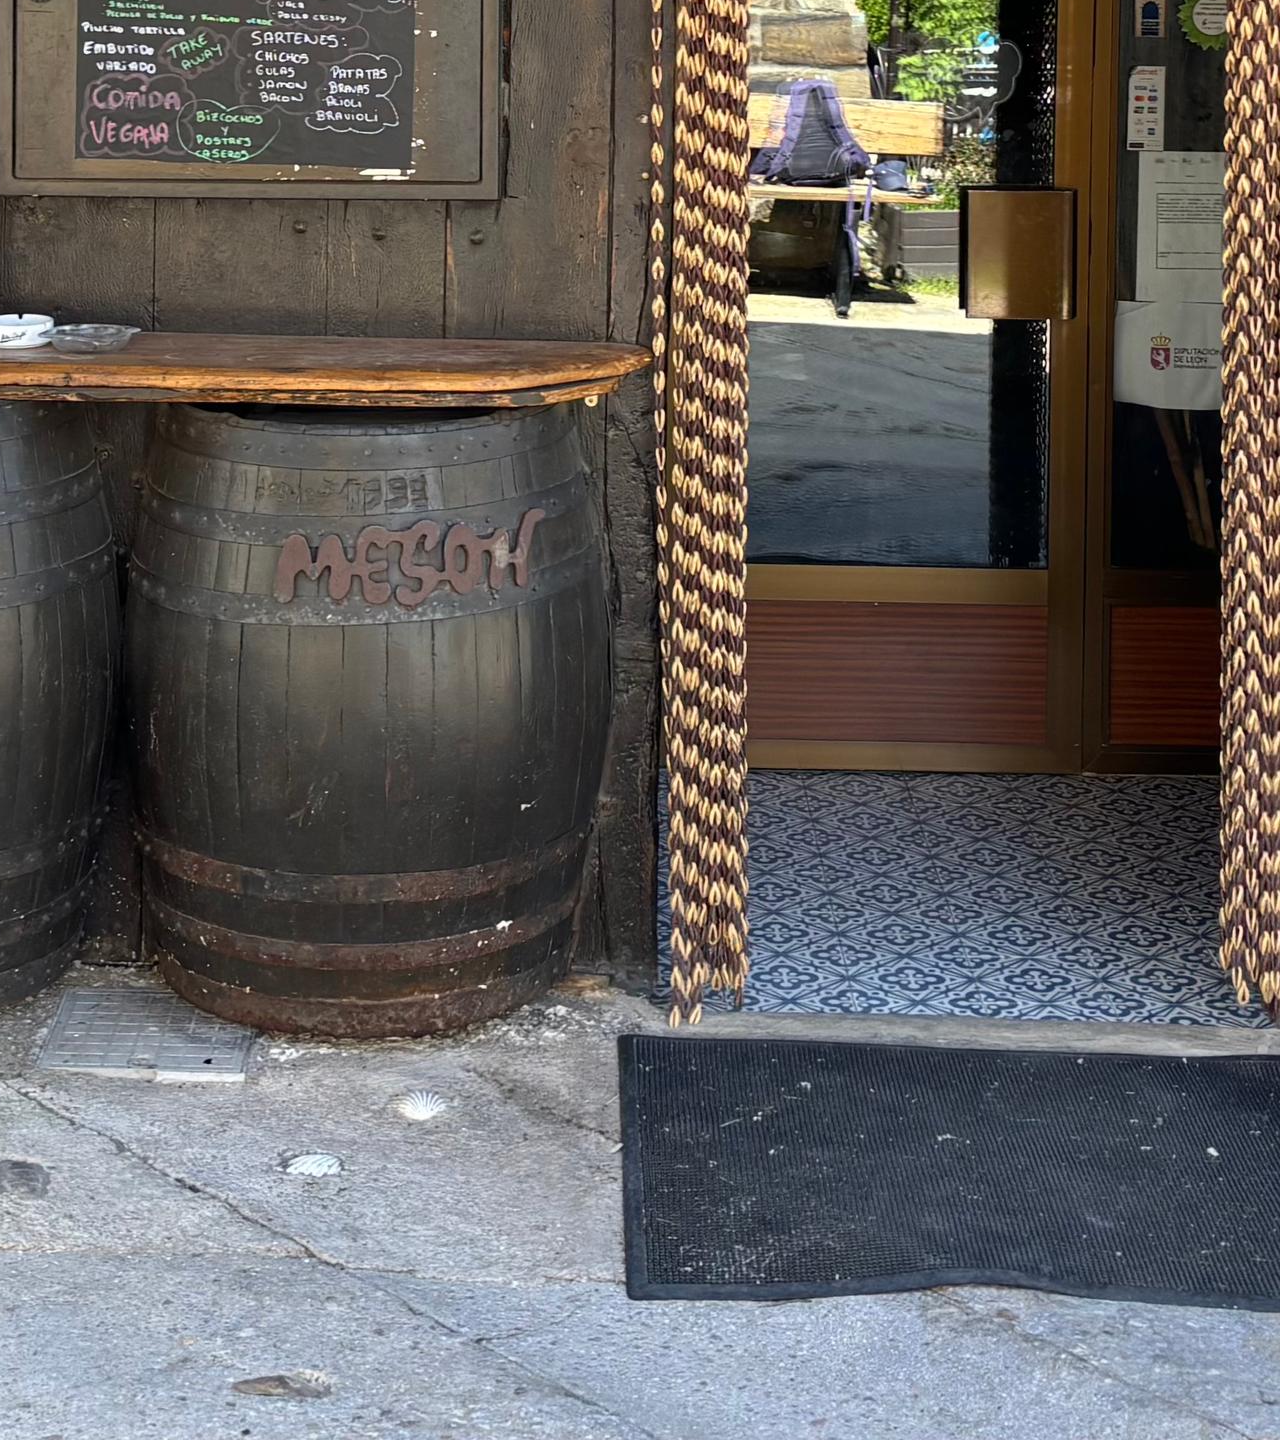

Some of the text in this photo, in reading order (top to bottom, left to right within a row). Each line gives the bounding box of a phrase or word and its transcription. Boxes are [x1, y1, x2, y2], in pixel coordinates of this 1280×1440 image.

[277, 0, 305, 9] VACA
[277, 11, 348, 25] POLLO CRISPY
[83, 41, 155, 56] EMBUTIDO
[166, 32, 208, 59] TAKE
[181, 43, 223, 71] AWAY
[255, 48, 309, 64] CHICHOS
[96, 61, 157, 75] VARIADO
[255, 64, 296, 78] GULAS
[330, 65, 388, 80] PATATAS
[257, 80, 308, 90] JAMON
[328, 81, 370, 95] BRAVAS
[92, 84, 181, 110] COMIDA
[259, 91, 304, 103] BACON
[195, 110, 264, 124] BIZCOCHOS
[315, 110, 378, 122] BRAVIOLI
[89, 116, 170, 149] VEGANA
[195, 135, 252, 147] POSTRES
[195, 149, 250, 159] CASEROS
[275, 508, 545, 609] MESON
